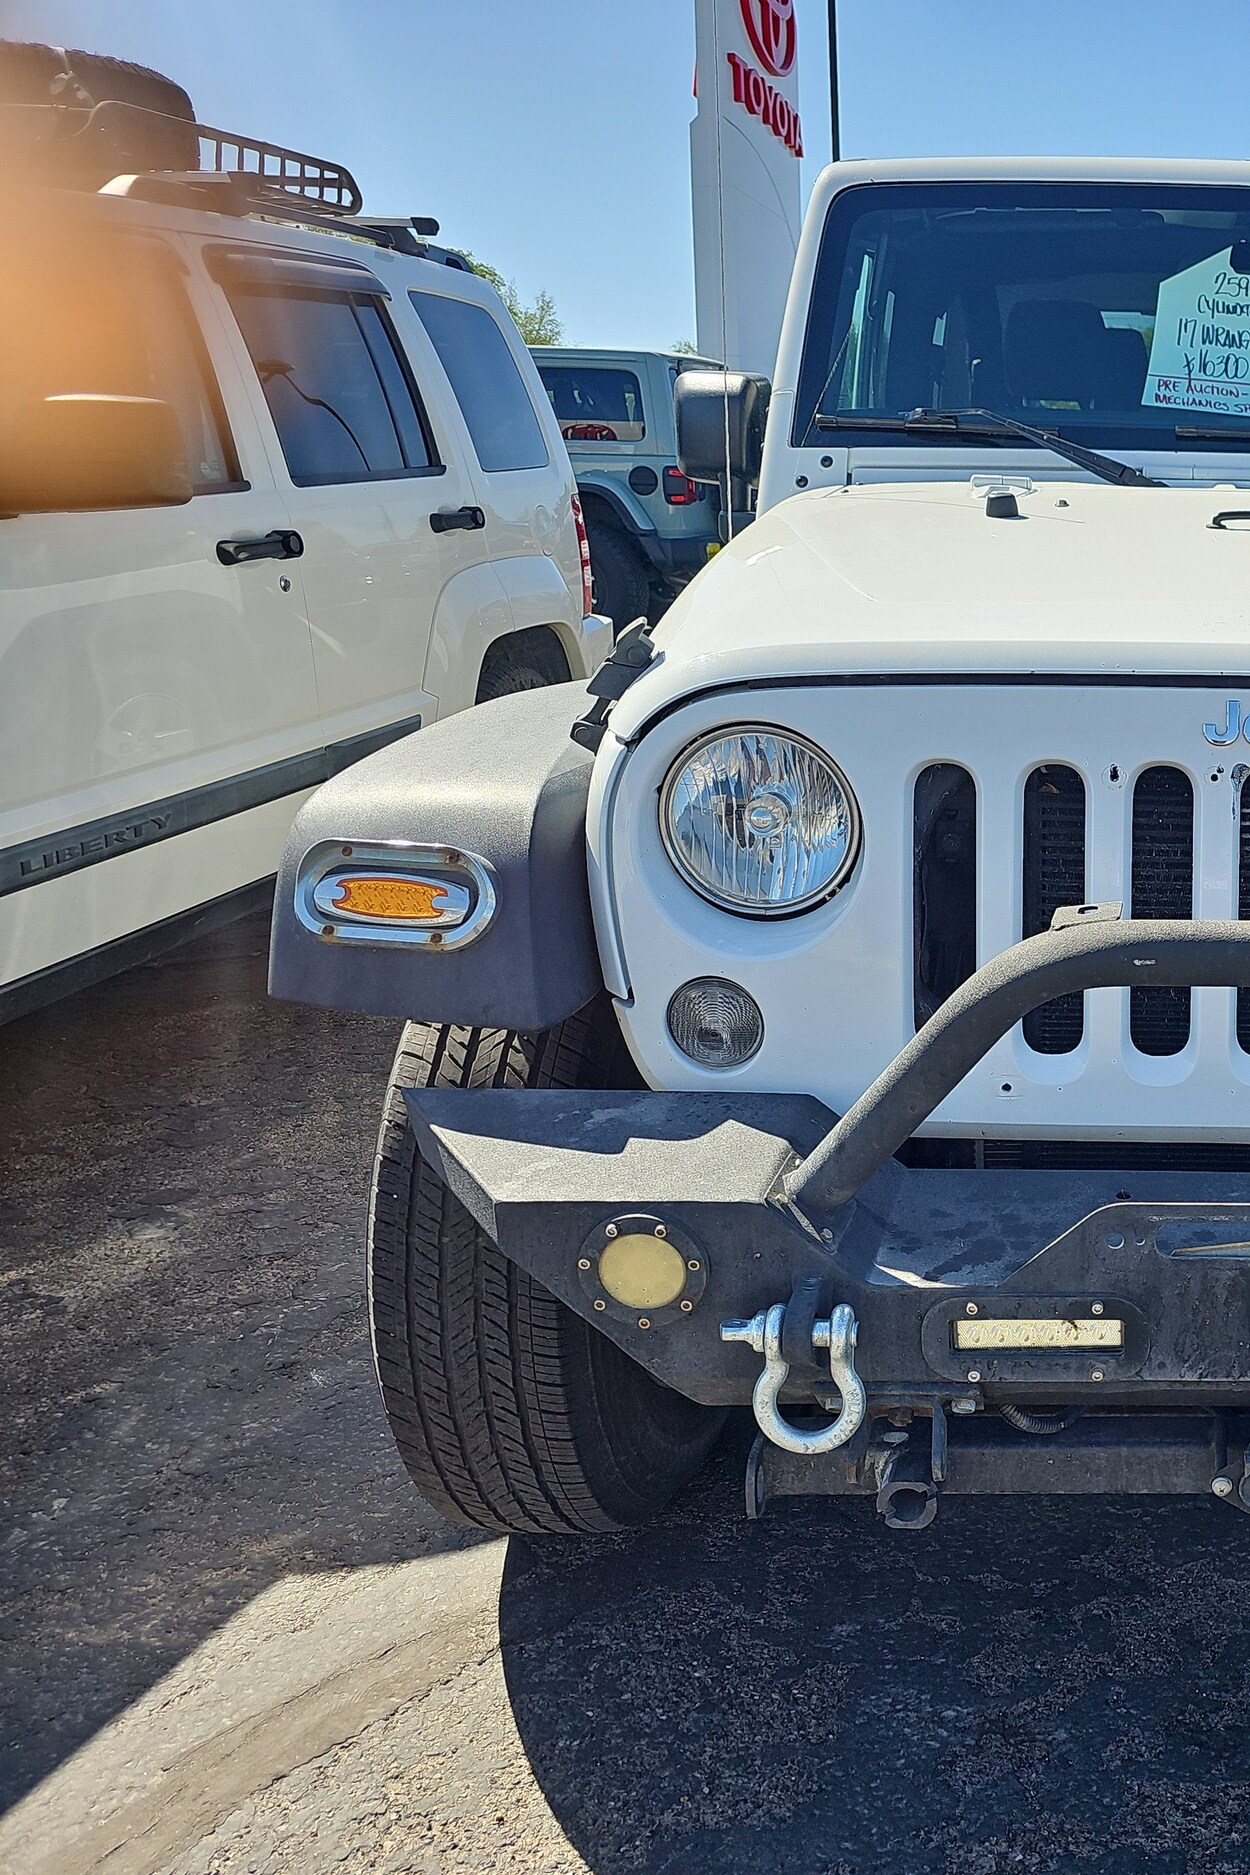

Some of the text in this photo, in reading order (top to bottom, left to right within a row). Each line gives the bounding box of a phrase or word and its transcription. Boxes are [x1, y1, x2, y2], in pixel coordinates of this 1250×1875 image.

[727, 53, 804, 158] TOYOTA
[1183, 348, 1249, 379] $16300
[1157, 379, 1182, 393] PRE
[1154, 393, 1230, 411] MECHANICS
[20, 813, 172, 876] LIBERTY
